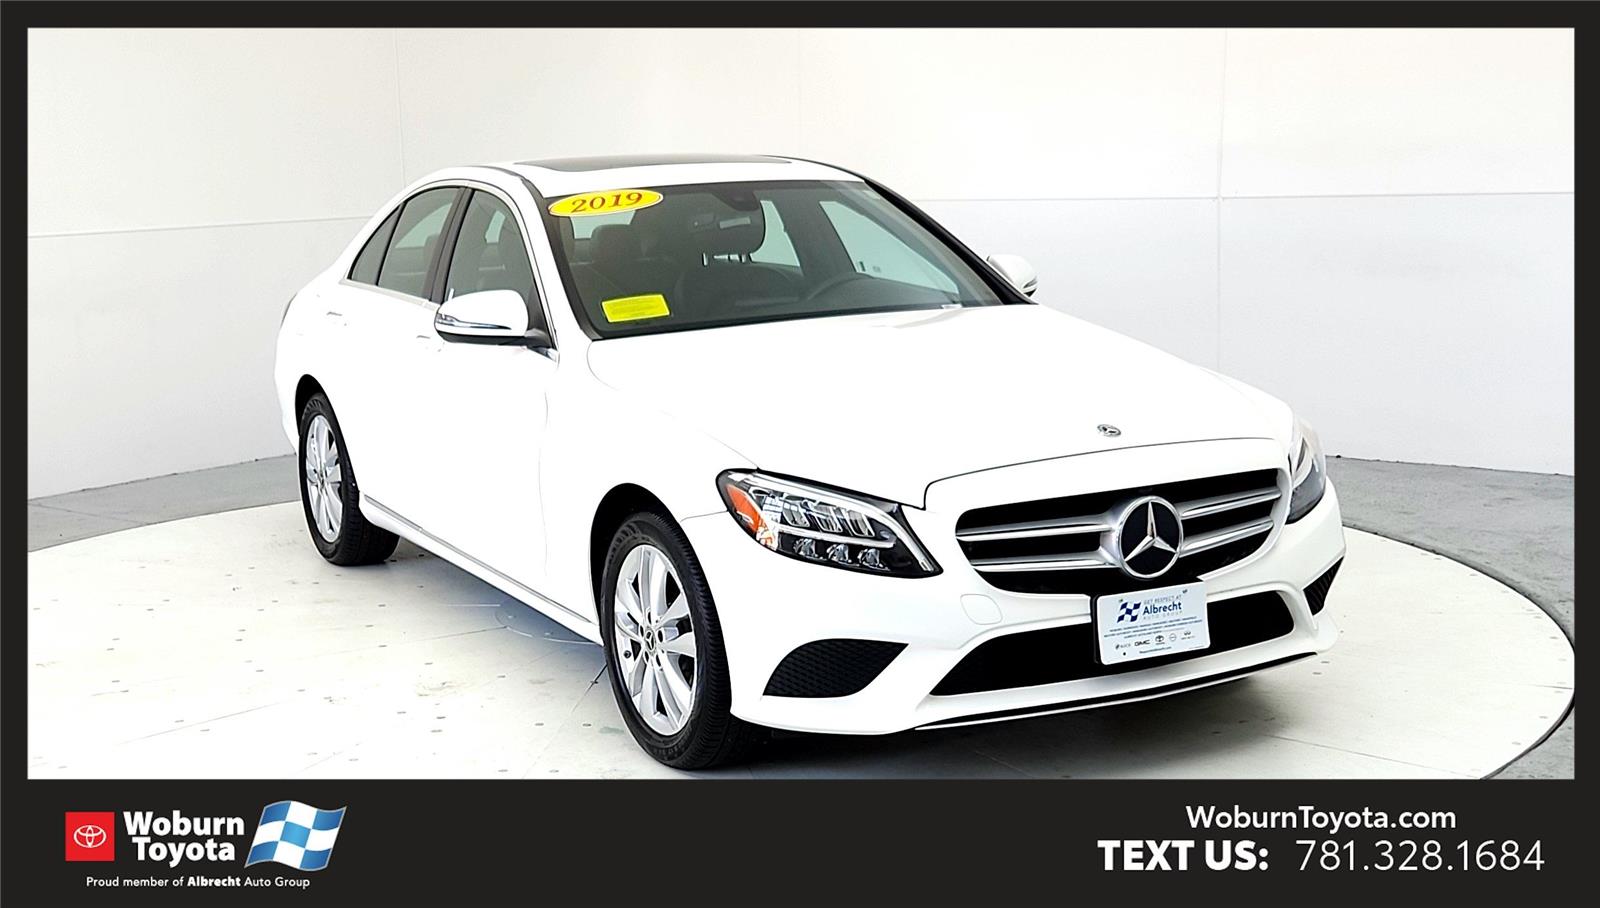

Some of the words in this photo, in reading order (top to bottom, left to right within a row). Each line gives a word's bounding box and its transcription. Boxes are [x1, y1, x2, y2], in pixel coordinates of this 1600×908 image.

[571, 191, 643, 214] 2019
[1142, 601, 1182, 615] Albrecht
[1134, 639, 1151, 647] GMC
